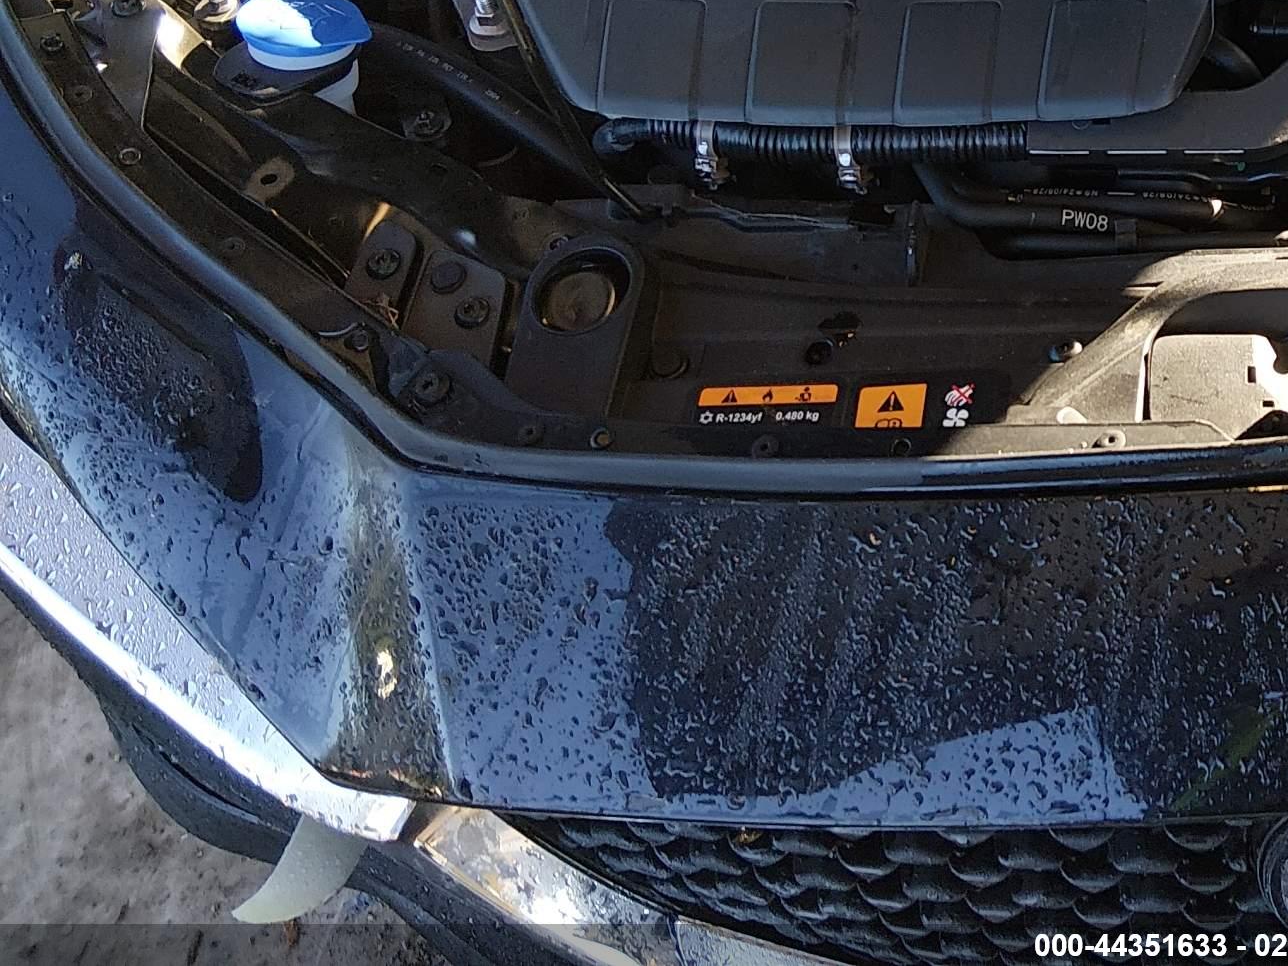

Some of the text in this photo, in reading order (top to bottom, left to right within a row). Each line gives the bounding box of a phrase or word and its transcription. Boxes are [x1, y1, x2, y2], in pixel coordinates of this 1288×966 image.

[1061, 209, 1108, 232] PW08
[715, 410, 820, 424] R-1234yf 0.480 kg
